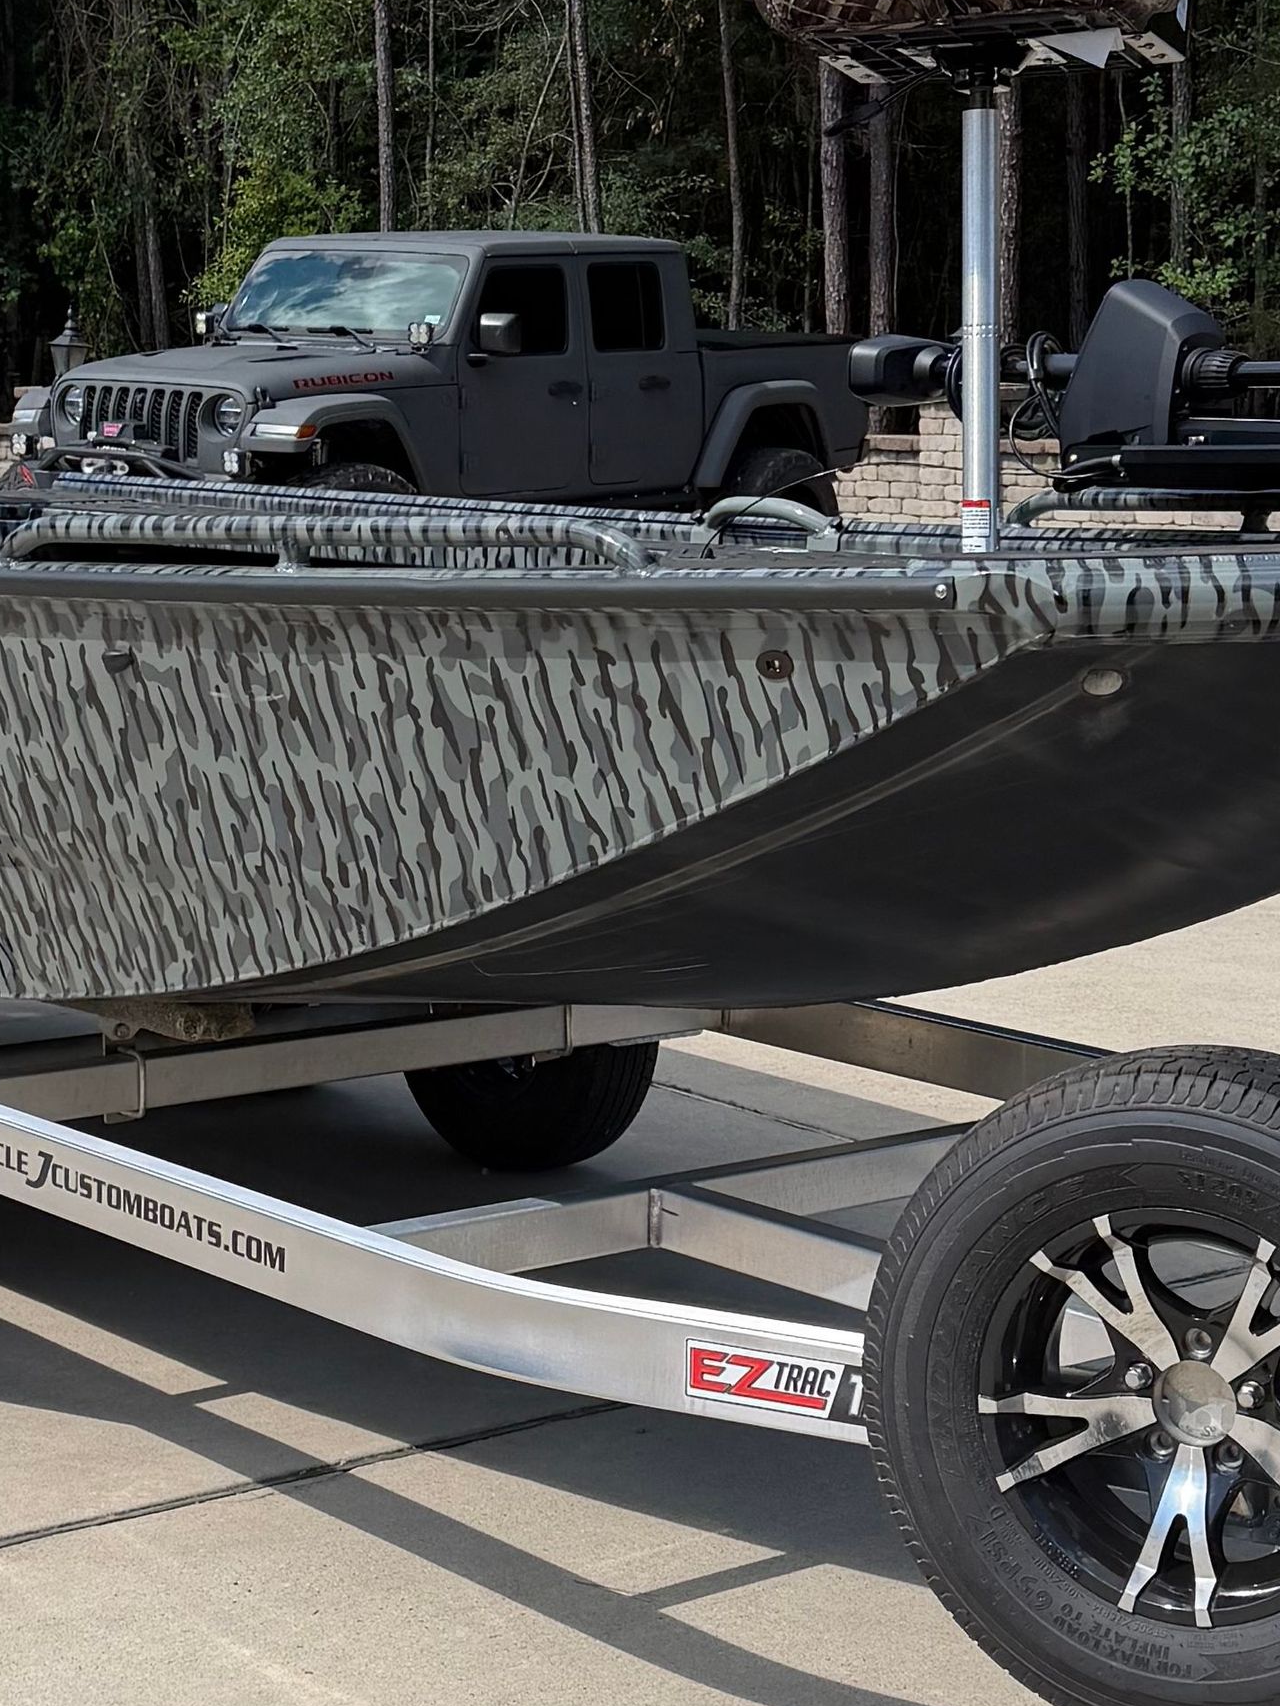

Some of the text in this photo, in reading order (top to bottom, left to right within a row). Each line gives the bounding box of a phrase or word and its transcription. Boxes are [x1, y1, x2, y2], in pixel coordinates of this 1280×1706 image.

[293, 371, 394, 390] RUBICON
[773, 1361, 836, 1398] TRAC
[1156, 1660, 1193, 1679] FOR
